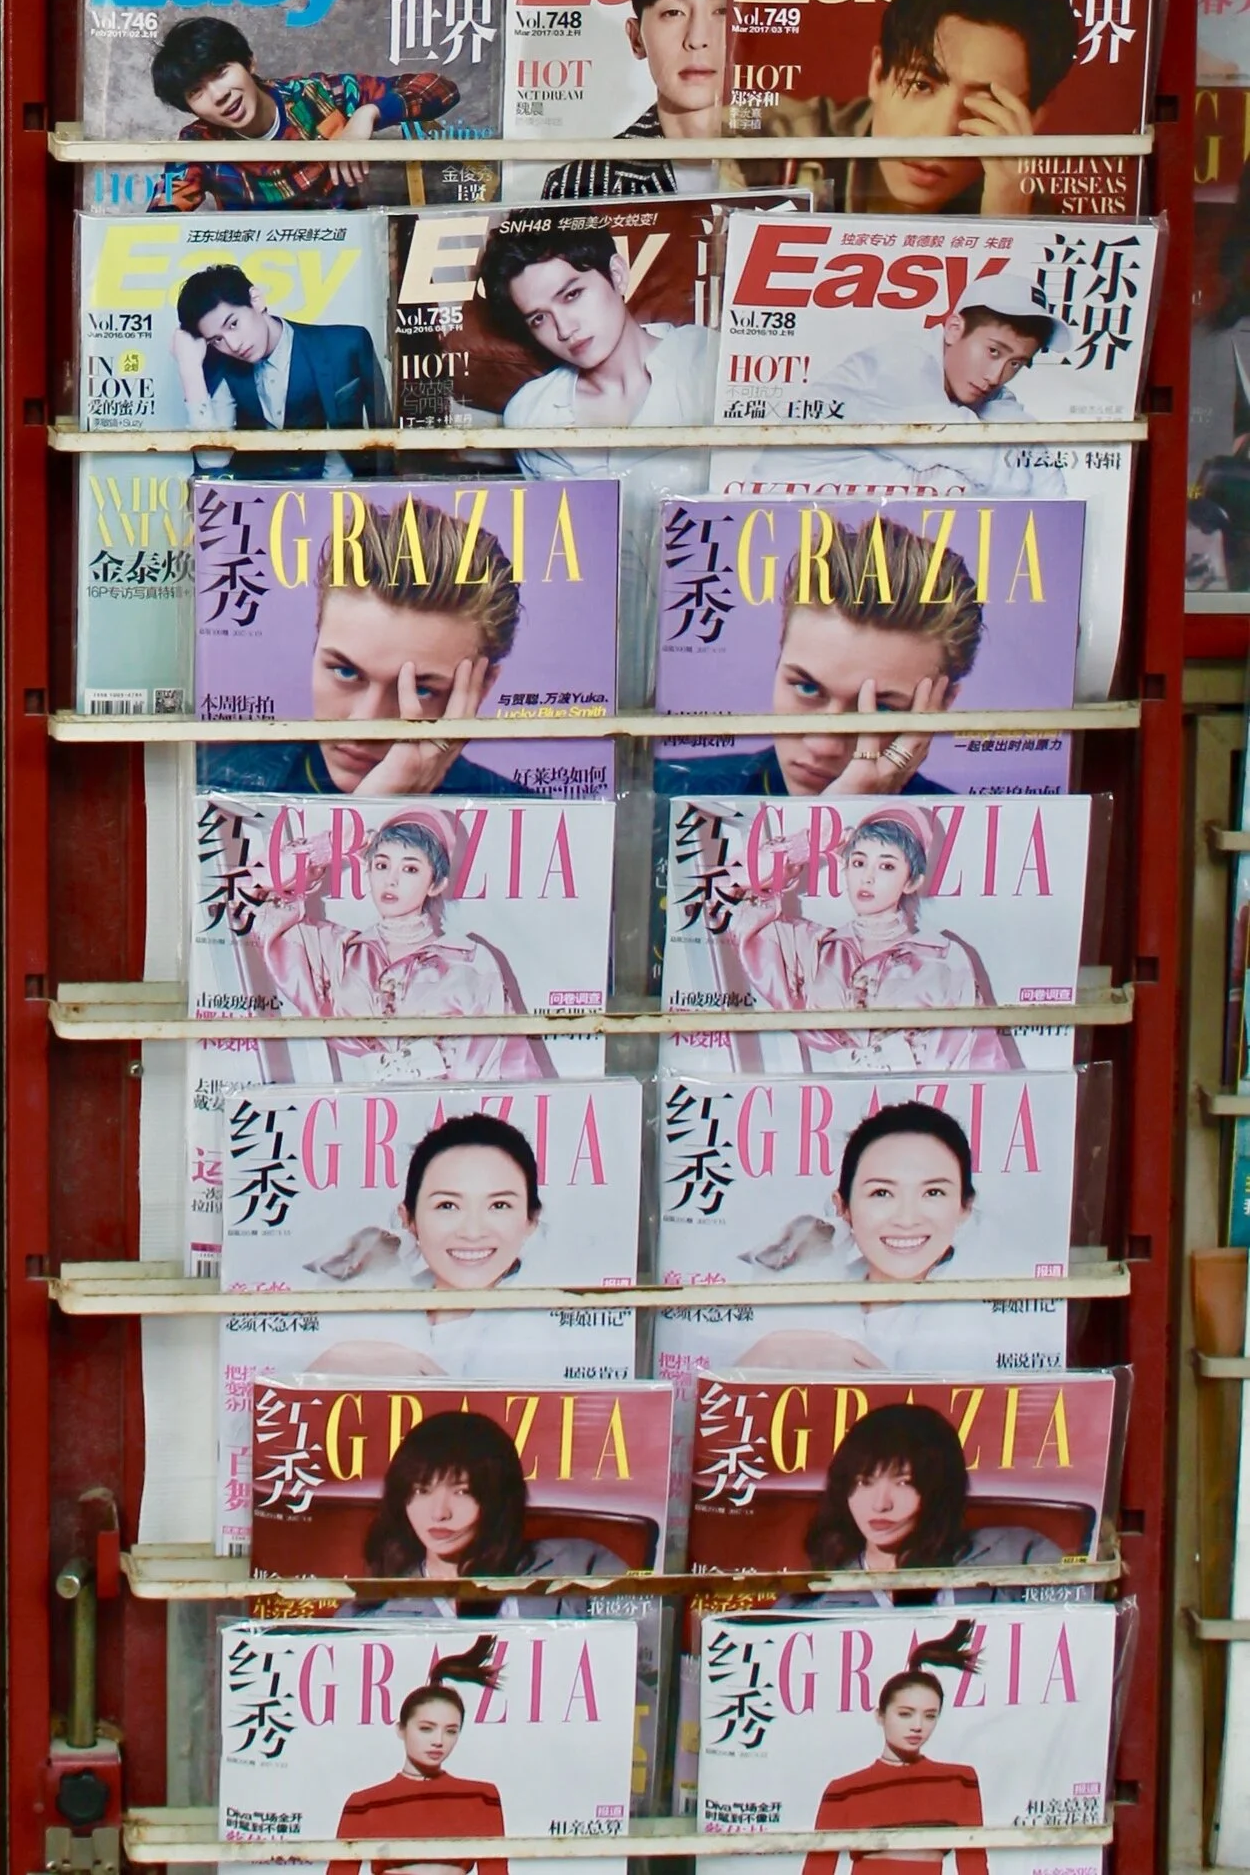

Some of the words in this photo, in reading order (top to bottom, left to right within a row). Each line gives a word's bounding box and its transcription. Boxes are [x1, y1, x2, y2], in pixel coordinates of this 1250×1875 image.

[93, 11, 159, 31] Vol.746
[516, 11, 582, 31] Vol.748
[731, 7, 801, 27] Vol.749
[516, 60, 592, 88] HOT
[733, 64, 801, 90] HOT
[730, 91, 779, 106] 郑容和
[441, 165, 492, 184] 金俊秀
[1017, 157, 1126, 175] BRILLIANT
[1020, 176, 1127, 195] OVERSEAS
[1061, 195, 1126, 214] STARS
[266, 227, 346, 242] 公开保鲜之道
[499, 218, 551, 234] SNH48
[732, 224, 1010, 329] Easy
[88, 313, 153, 332] Vol.731
[396, 307, 463, 327] Vol.735
[730, 310, 796, 329] Vol.738
[88, 356, 113, 377] IN
[402, 352, 470, 380] HOT!
[728, 354, 810, 384] HOT!
[88, 377, 155, 399] LOVE
[269, 488, 583, 589] GRAZIA
[89, 550, 195, 584] 金泰焕
[197, 488, 271, 626] 红秀
[737, 508, 1046, 607] GRAZIA
[201, 694, 275, 714] 本周街拍
[514, 766, 606, 786] 好莱坞如何
[268, 805, 578, 900] GRZIA
[675, 802, 743, 935] 红秀
[196, 993, 283, 1010] 击破玻璃心
[550, 992, 603, 1005] 问卷调查
[225, 1314, 319, 1333] 必须不急不躁
[996, 1352, 1061, 1368] 据说青豆
[255, 1387, 324, 1514] 红秀
[707, 1631, 776, 1749] 红秀
[226, 1807, 303, 1823] Diva气场全开
[705, 1811, 780, 1824] 时髦到不像话
[549, 1819, 623, 1836] 相亲总算
